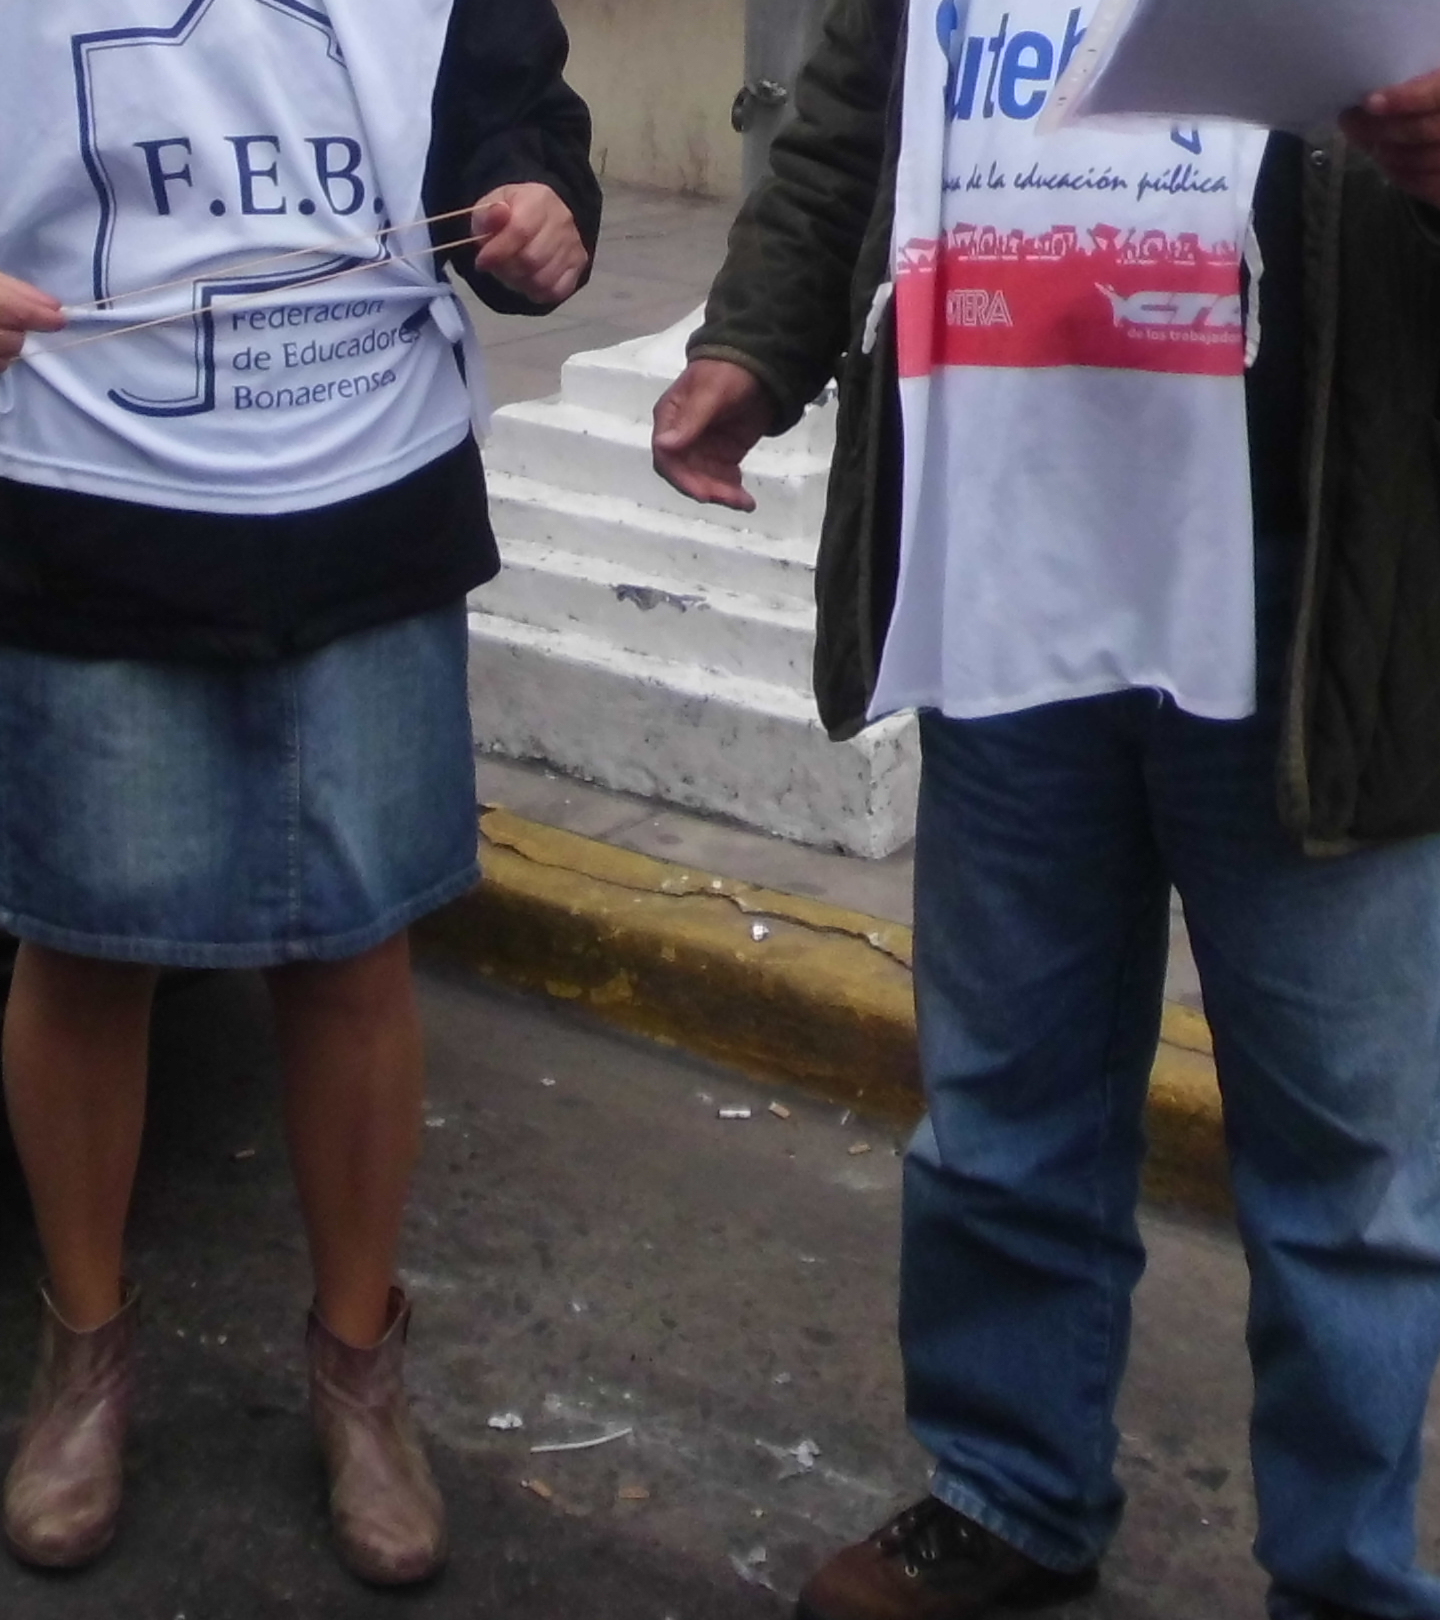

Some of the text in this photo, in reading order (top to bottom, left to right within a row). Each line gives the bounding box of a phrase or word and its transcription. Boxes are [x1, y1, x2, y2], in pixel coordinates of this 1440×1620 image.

[133, 134, 384, 217] F.E.B.
[987, 160, 1006, 190] la
[1013, 162, 1128, 191] educación
[1136, 164, 1228, 201] pública
[232, 346, 272, 371] de
